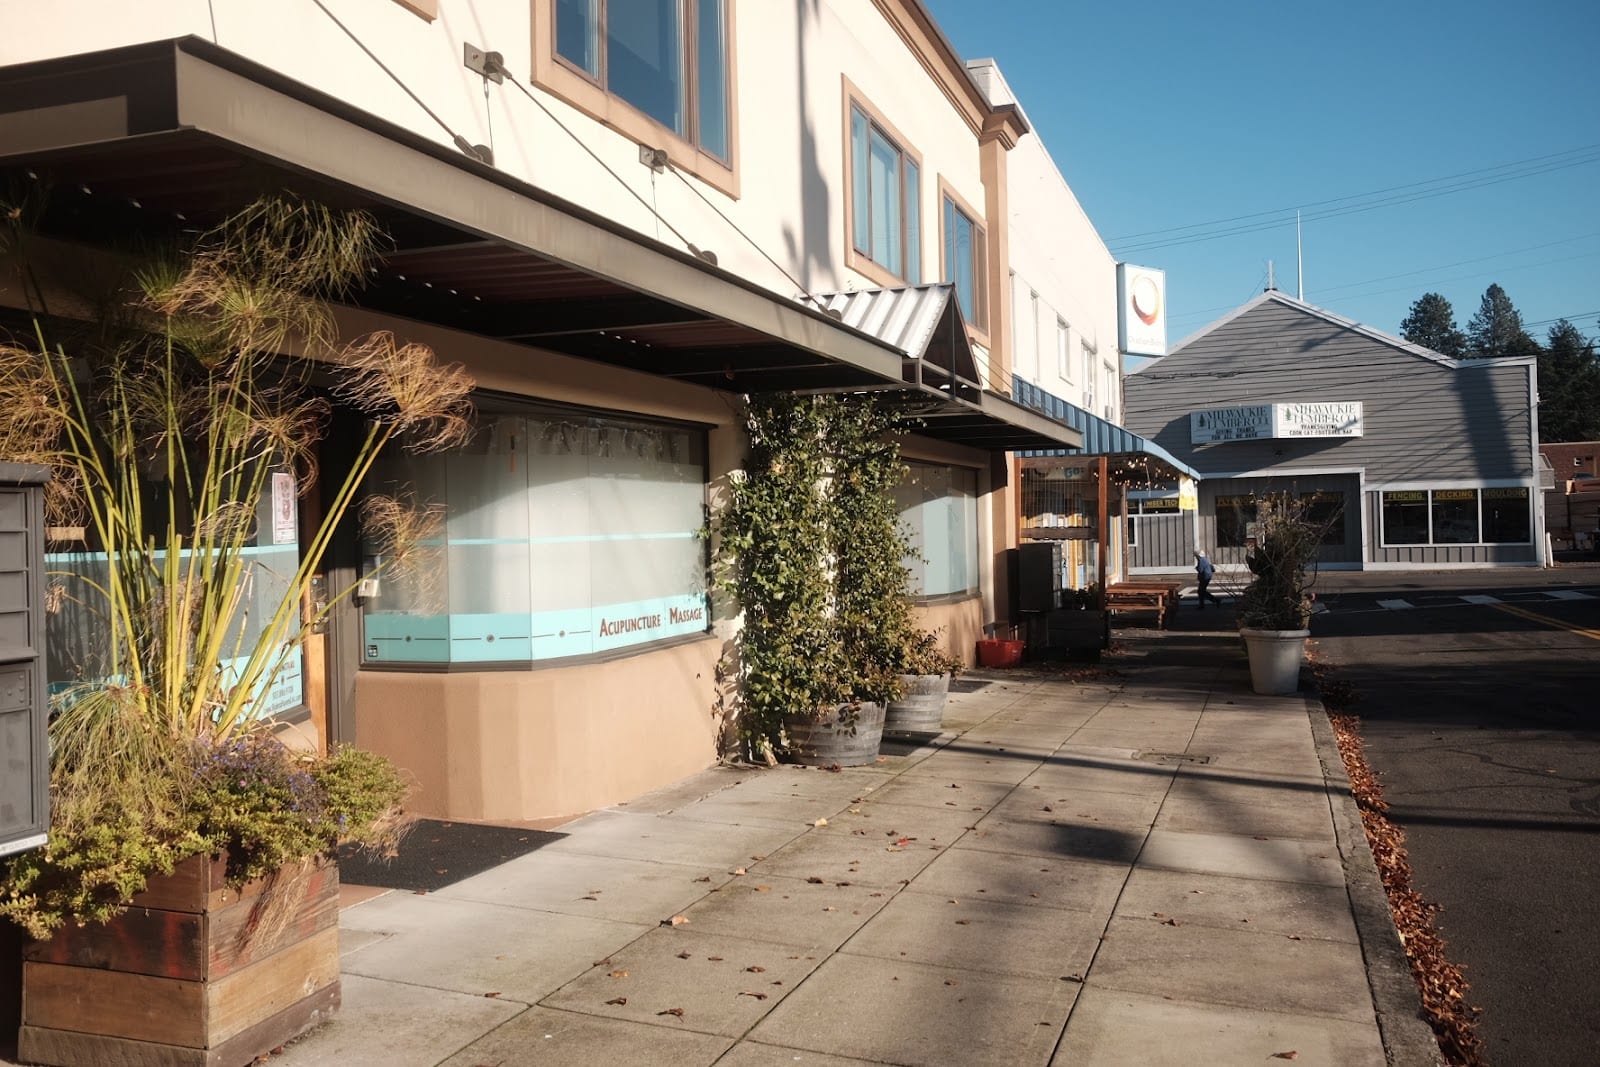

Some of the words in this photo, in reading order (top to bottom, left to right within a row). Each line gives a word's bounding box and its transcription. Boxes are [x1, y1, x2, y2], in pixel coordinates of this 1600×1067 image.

[1207, 406, 1266, 420] MILWAUKIE
[1294, 404, 1355, 415] MILWAUKIE
[1388, 491, 1423, 500] FENCING
[1436, 489, 1473, 499] DECKING
[600, 614, 661, 637] ACUPUNCTURE
[669, 607, 703, 625] MASSAGE
